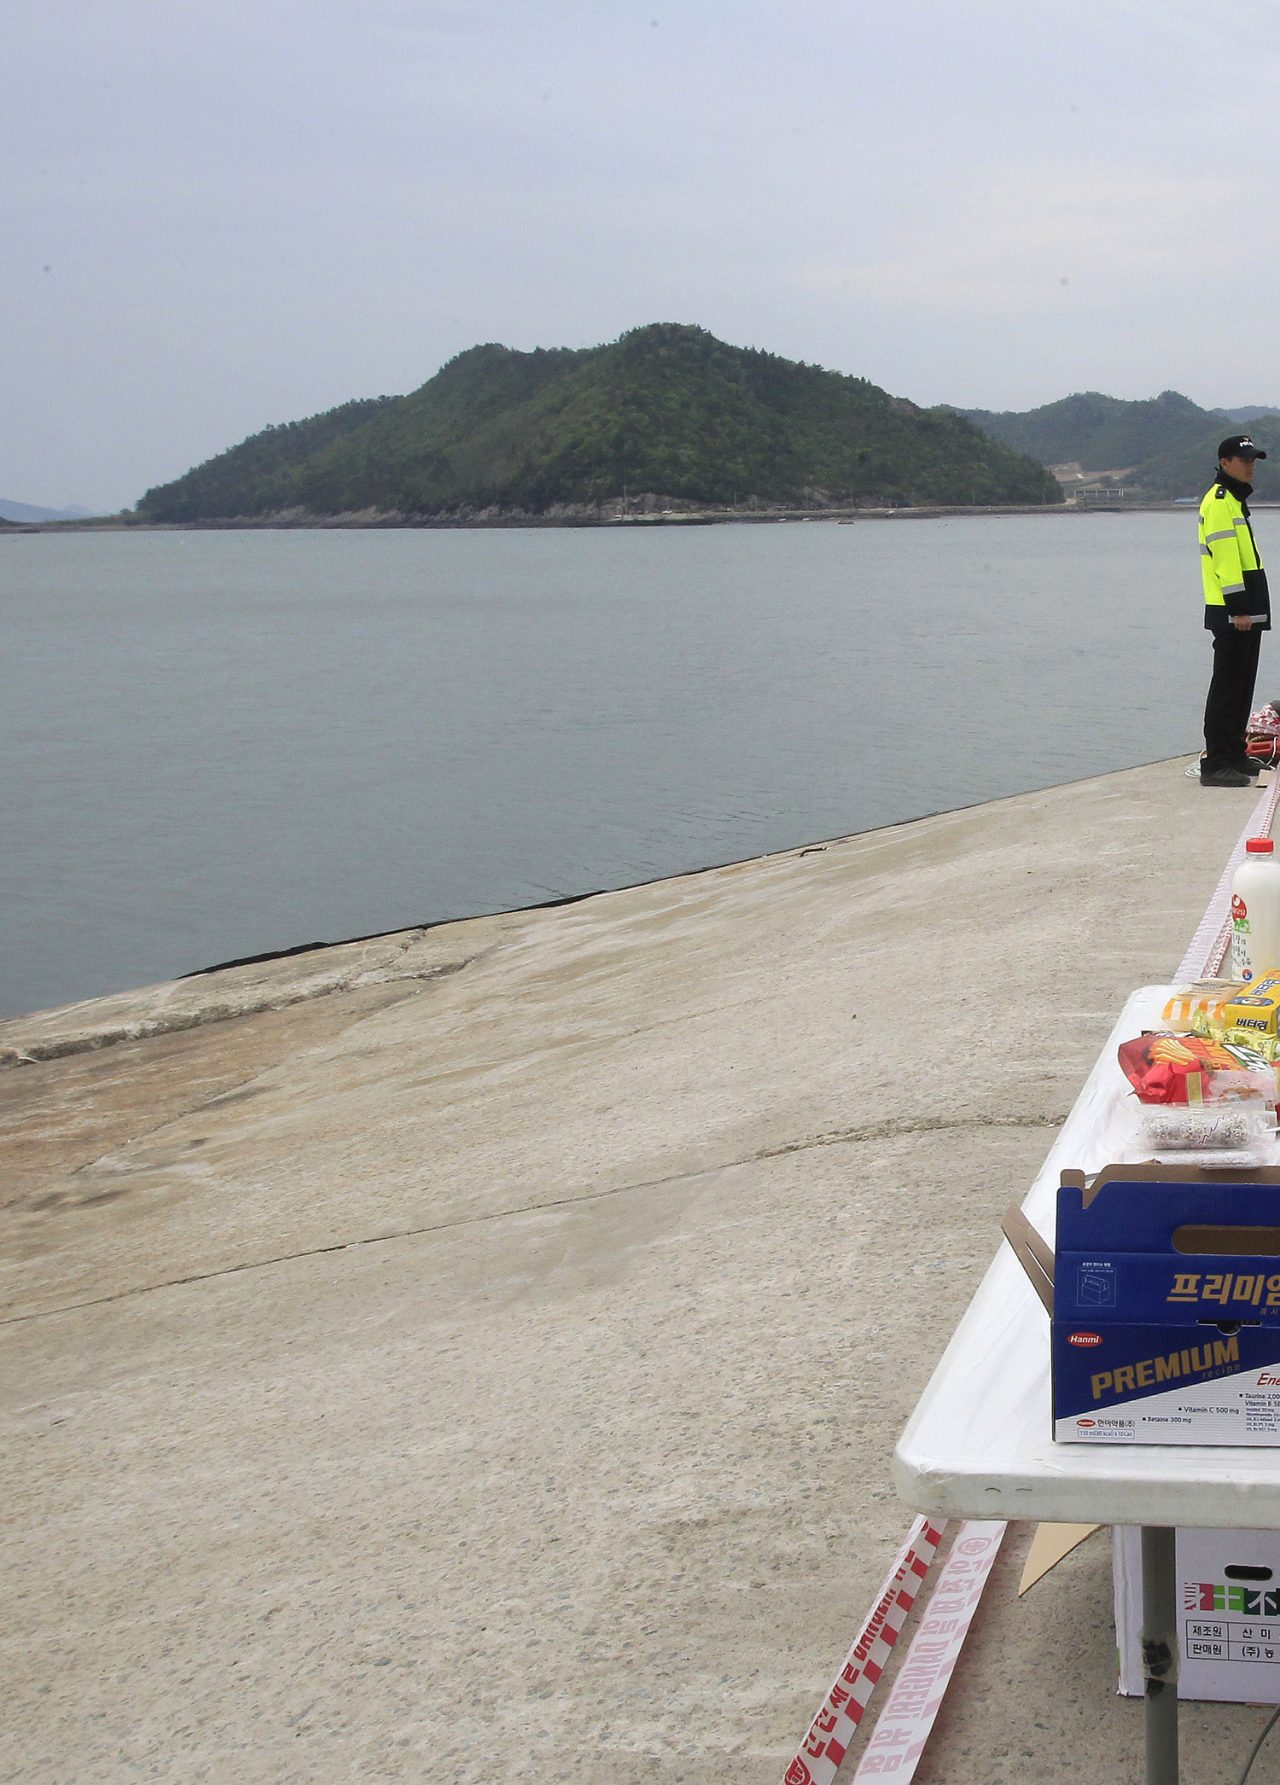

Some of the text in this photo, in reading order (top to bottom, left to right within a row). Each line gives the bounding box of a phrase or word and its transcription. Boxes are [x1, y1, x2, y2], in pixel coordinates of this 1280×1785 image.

[1236, 1018, 1269, 1031] 버터링
[1070, 1335, 1100, 1344] Hanmi
[1090, 1336, 1240, 1400] PREMIUM
[1202, 1363, 1241, 1379] recipe
[1192, 1625, 1222, 1637] 제조원
[1192, 1643, 1222, 1655] 판매원
